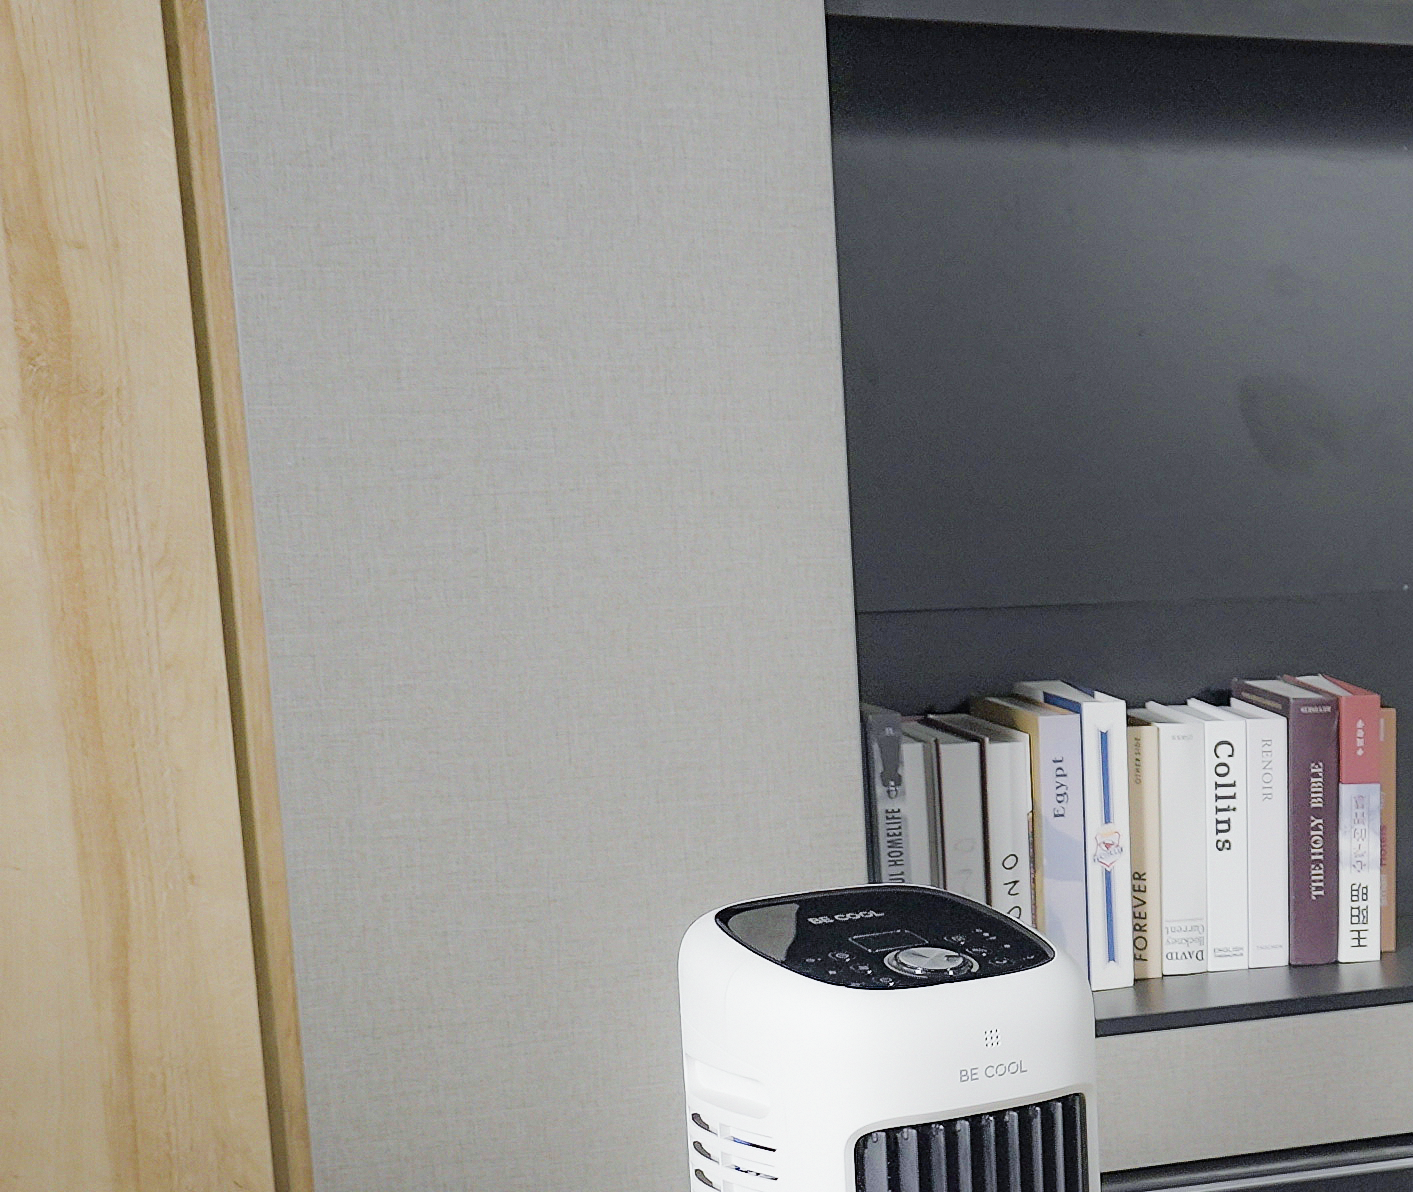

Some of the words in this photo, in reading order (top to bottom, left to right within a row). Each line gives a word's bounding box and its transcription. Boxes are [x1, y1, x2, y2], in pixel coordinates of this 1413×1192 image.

[1052, 756, 1070, 819] Egypt
[1213, 740, 1237, 852] Collins
[1261, 739, 1274, 801] RENOIR
[1310, 761, 1324, 808] BIBLE
[884, 807, 904, 867] HOMELIFE
[1310, 816, 1324, 862] HOLY
[1311, 864, 1326, 900] THE
[1132, 871, 1147, 962] FOREVER
[1349, 882, 1369, 948] 王阳明
[1165, 949, 1204, 961] DAVID
[959, 1066, 980, 1083] BE
[984, 1059, 1028, 1079] COOL
